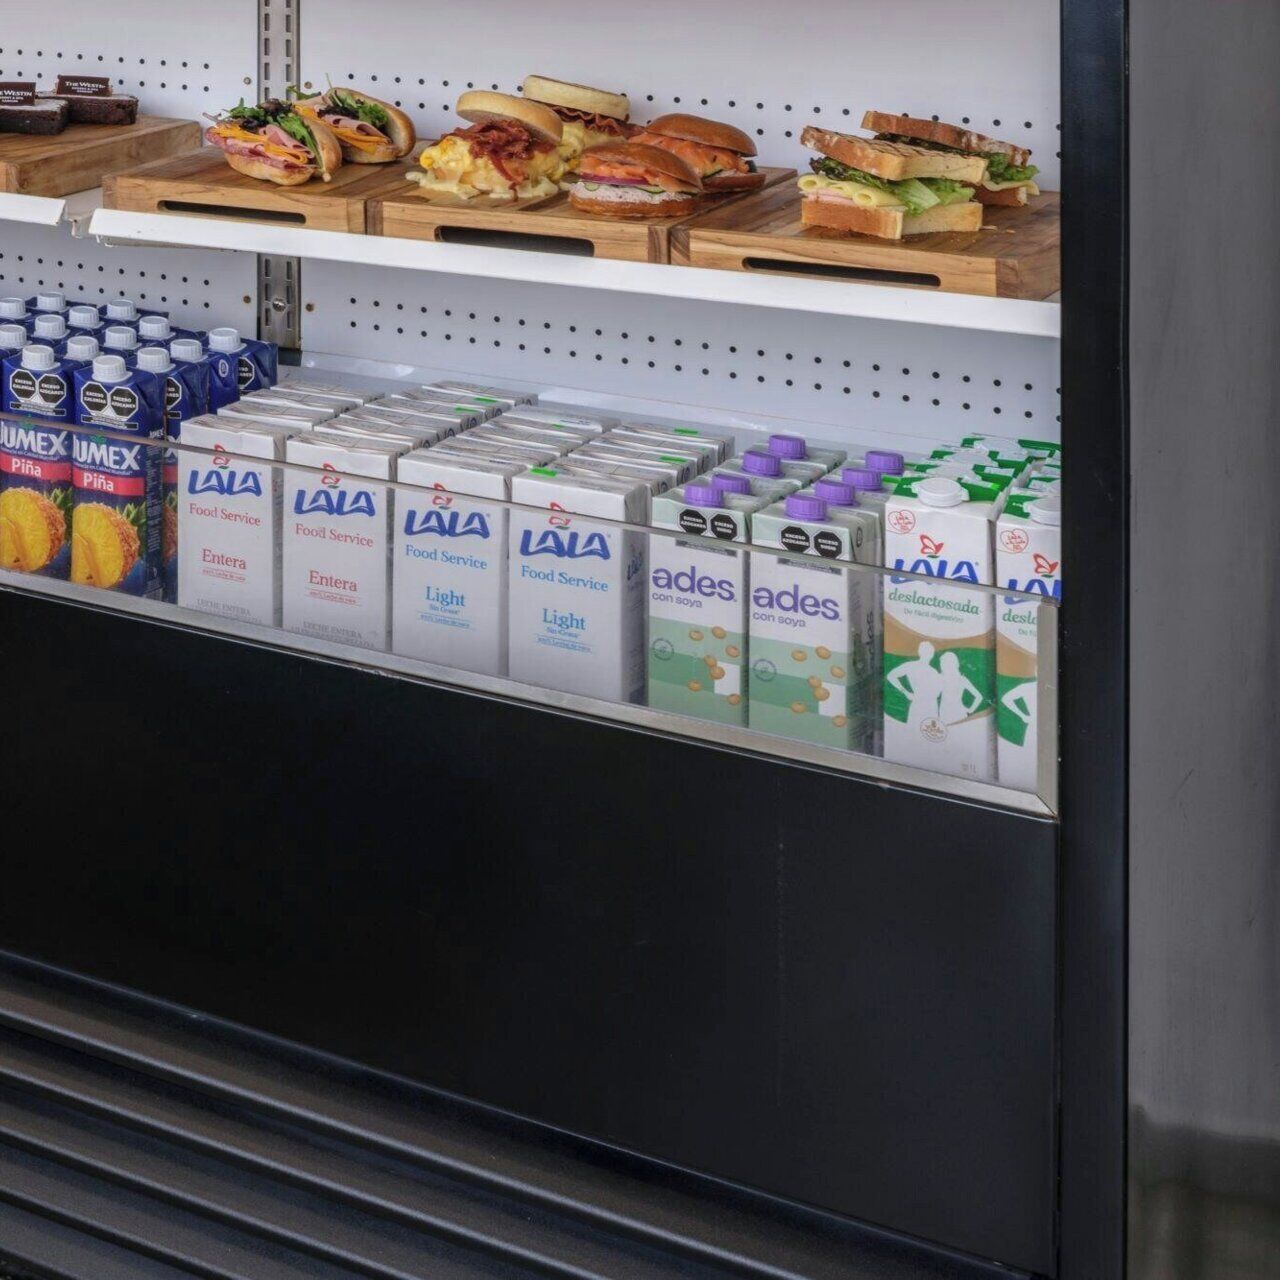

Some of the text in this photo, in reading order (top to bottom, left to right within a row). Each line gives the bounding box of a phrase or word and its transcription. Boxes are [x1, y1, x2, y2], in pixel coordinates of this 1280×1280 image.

[11, 457, 42, 478] Piña
[83, 472, 115, 492] Piña
[187, 469, 263, 497] LALA
[190, 502, 261, 526] Food Service
[293, 489, 376, 517] LALA
[295, 522, 374, 547] Food Service
[404, 509, 490, 539] LALA
[405, 543, 488, 570] Food Service
[520, 529, 611, 560] LALA
[202, 548, 247, 570] Entera
[308, 570, 357, 592] Entera
[521, 564, 608, 592] Food Service
[652, 565, 736, 602] ades
[425, 585, 466, 607] Light
[652, 591, 703, 609] con soya
[752, 583, 841, 621] ades
[888, 587, 980, 616] deslactosada
[542, 607, 587, 631] Light
[752, 609, 806, 628] con soya
